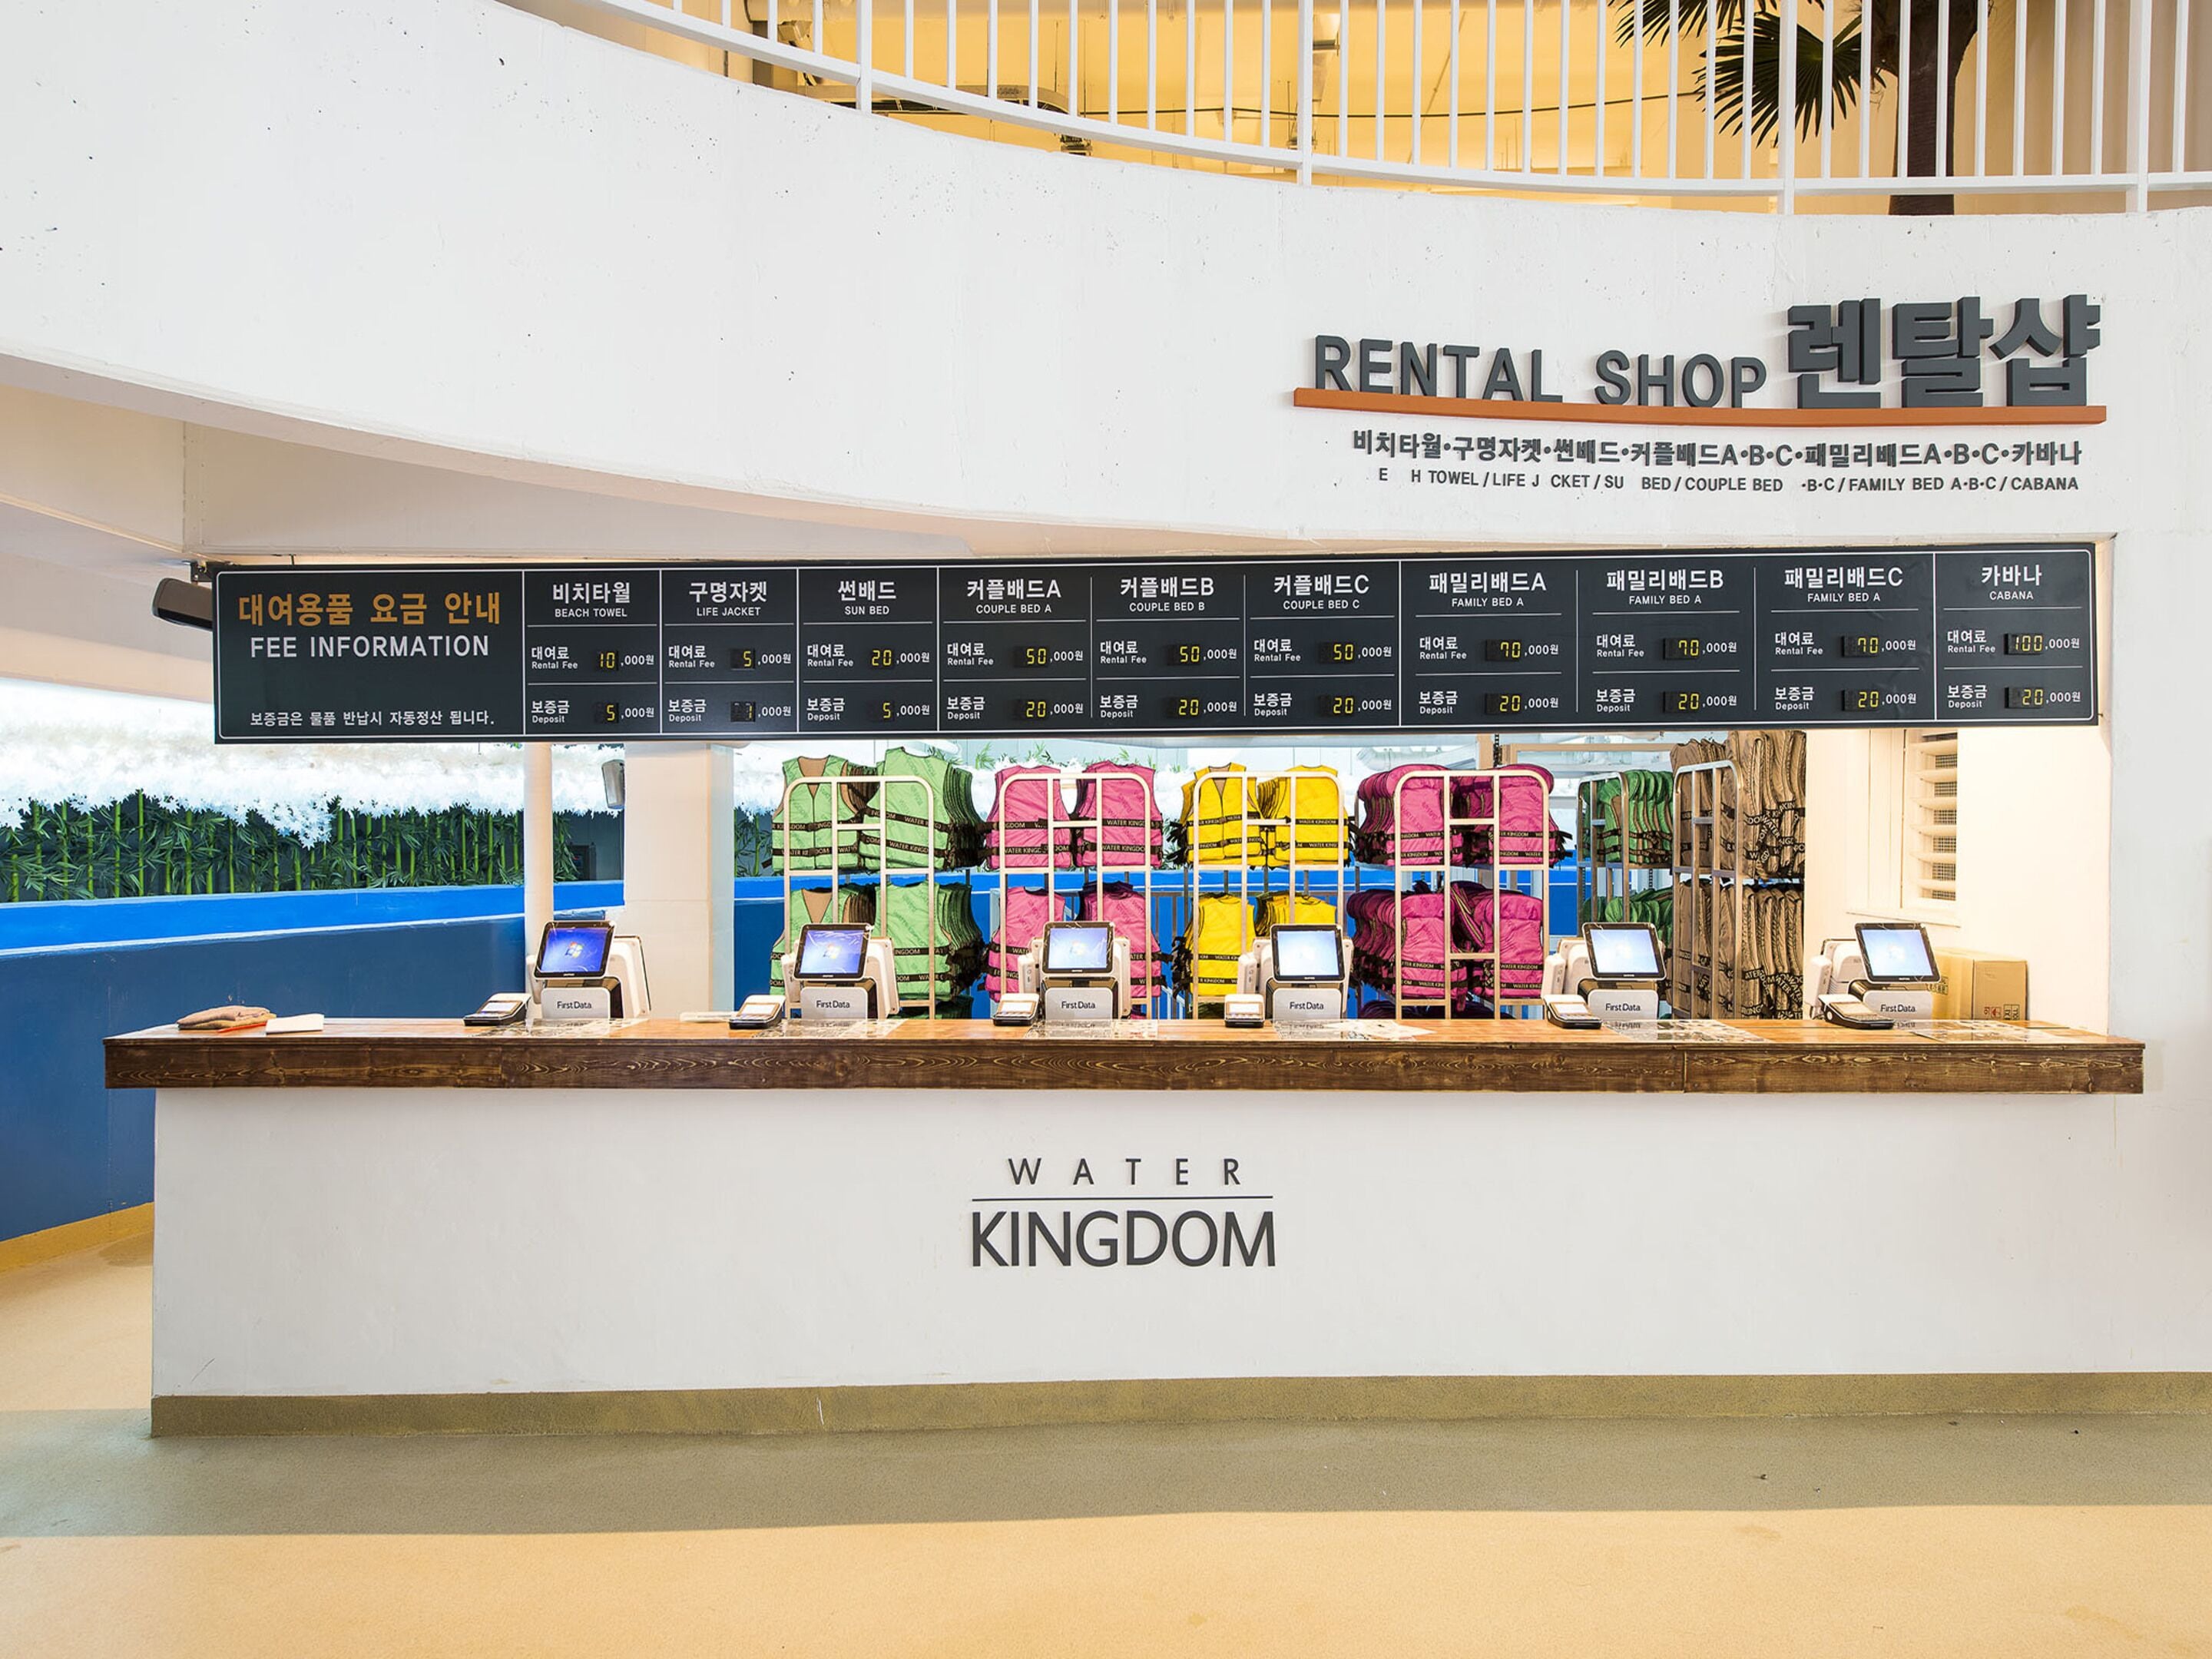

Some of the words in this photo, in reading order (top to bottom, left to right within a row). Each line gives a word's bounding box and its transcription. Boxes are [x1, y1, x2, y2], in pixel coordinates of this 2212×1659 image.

[1788, 295, 2100, 409] 렌탈샵
[1316, 336, 1562, 400] RENTAL
[1594, 350, 1767, 408] SHOP
[1753, 478, 1783, 492] BED
[1913, 478, 1943, 490] BED
[1429, 571, 1546, 594] 패밀리배드A
[1607, 569, 1723, 591] 패밀리배드B
[1785, 567, 1902, 588] 패밀리배드C
[1982, 565, 2042, 586] 카바나
[689, 581, 767, 602] 구명자켓
[838, 581, 896, 601] 썬배드
[968, 579, 1061, 600] 커플배드A
[1121, 577, 1214, 598] 커플배드B
[1274, 575, 1369, 596] 커플배드C
[553, 582, 630, 604] 비치타월
[1629, 595, 1665, 604] FAMILY
[1670, 595, 1690, 604] BED
[1808, 593, 1843, 602] FAMILY
[1849, 593, 1869, 601] BED
[1873, 593, 1880, 601] A
[1989, 591, 2034, 600] CABANA
[240, 594, 353, 625] 대여용품
[371, 594, 426, 624] 요금
[445, 592, 498, 624] 안내
[976, 604, 1015, 614] COUPLE
[1021, 604, 1040, 613] BED
[1130, 602, 1170, 611] COUPLE
[1174, 602, 1194, 611] BED
[1199, 602, 1204, 611] B
[1283, 601, 1323, 609] COUPLE
[1329, 600, 1348, 608] BED
[1353, 600, 1359, 608] C
[1452, 598, 1488, 607] FAMILY
[1492, 598, 1512, 606] BED
[1516, 598, 1524, 606] A
[555, 608, 589, 617] BEACH
[594, 608, 627, 617] TOWEL
[697, 608, 718, 616] LIFE
[722, 608, 760, 616] JACKET
[845, 606, 865, 614] SUN
[869, 606, 889, 614] BED
[1420, 637, 1458, 652] 대여료
[1597, 634, 1635, 648] 대여료
[1775, 632, 1814, 647] 대여료
[1947, 630, 1987, 645] 대여료
[251, 637, 296, 657] FEE
[311, 635, 488, 657] INFORMATION
[669, 645, 707, 659] 대여료
[807, 644, 845, 657] 대여료
[948, 643, 985, 656] 대여료
[1101, 641, 1137, 656] 대여료
[1254, 639, 1292, 654] 대여료
[1979, 644, 1995, 653] Fee
[531, 647, 569, 660] 대여료
[1419, 691, 1458, 705] 보증금
[1596, 689, 1635, 703] 보증금
[1774, 687, 1814, 700] 보증금
[1947, 685, 1987, 699] 보증금
[531, 700, 569, 714] 보증금
[668, 699, 707, 713] 보증금
[806, 698, 845, 712] 보증금
[947, 697, 985, 710] 보증금
[1100, 695, 1138, 709] 보증금
[1253, 694, 1292, 707] 보증금
[1598, 702, 1630, 713] Deposit
[1776, 702, 1809, 710] Deposit
[1949, 698, 1982, 709] Deposit
[250, 712, 303, 726] 보증금은
[310, 712, 336, 726] 물품
[343, 711, 381, 725] 반납시
[390, 711, 442, 725] 자동정산
[450, 710, 494, 724] 됩니다.
[532, 715, 565, 724] Deposit
[669, 714, 701, 723] Deposit
[808, 711, 839, 721] Deposit
[1101, 708, 1133, 719] Deposit
[1255, 708, 1286, 717] Deposit
[1008, 1158, 1240, 1185] WATER
[972, 1210, 1275, 1267] KINGDOM
